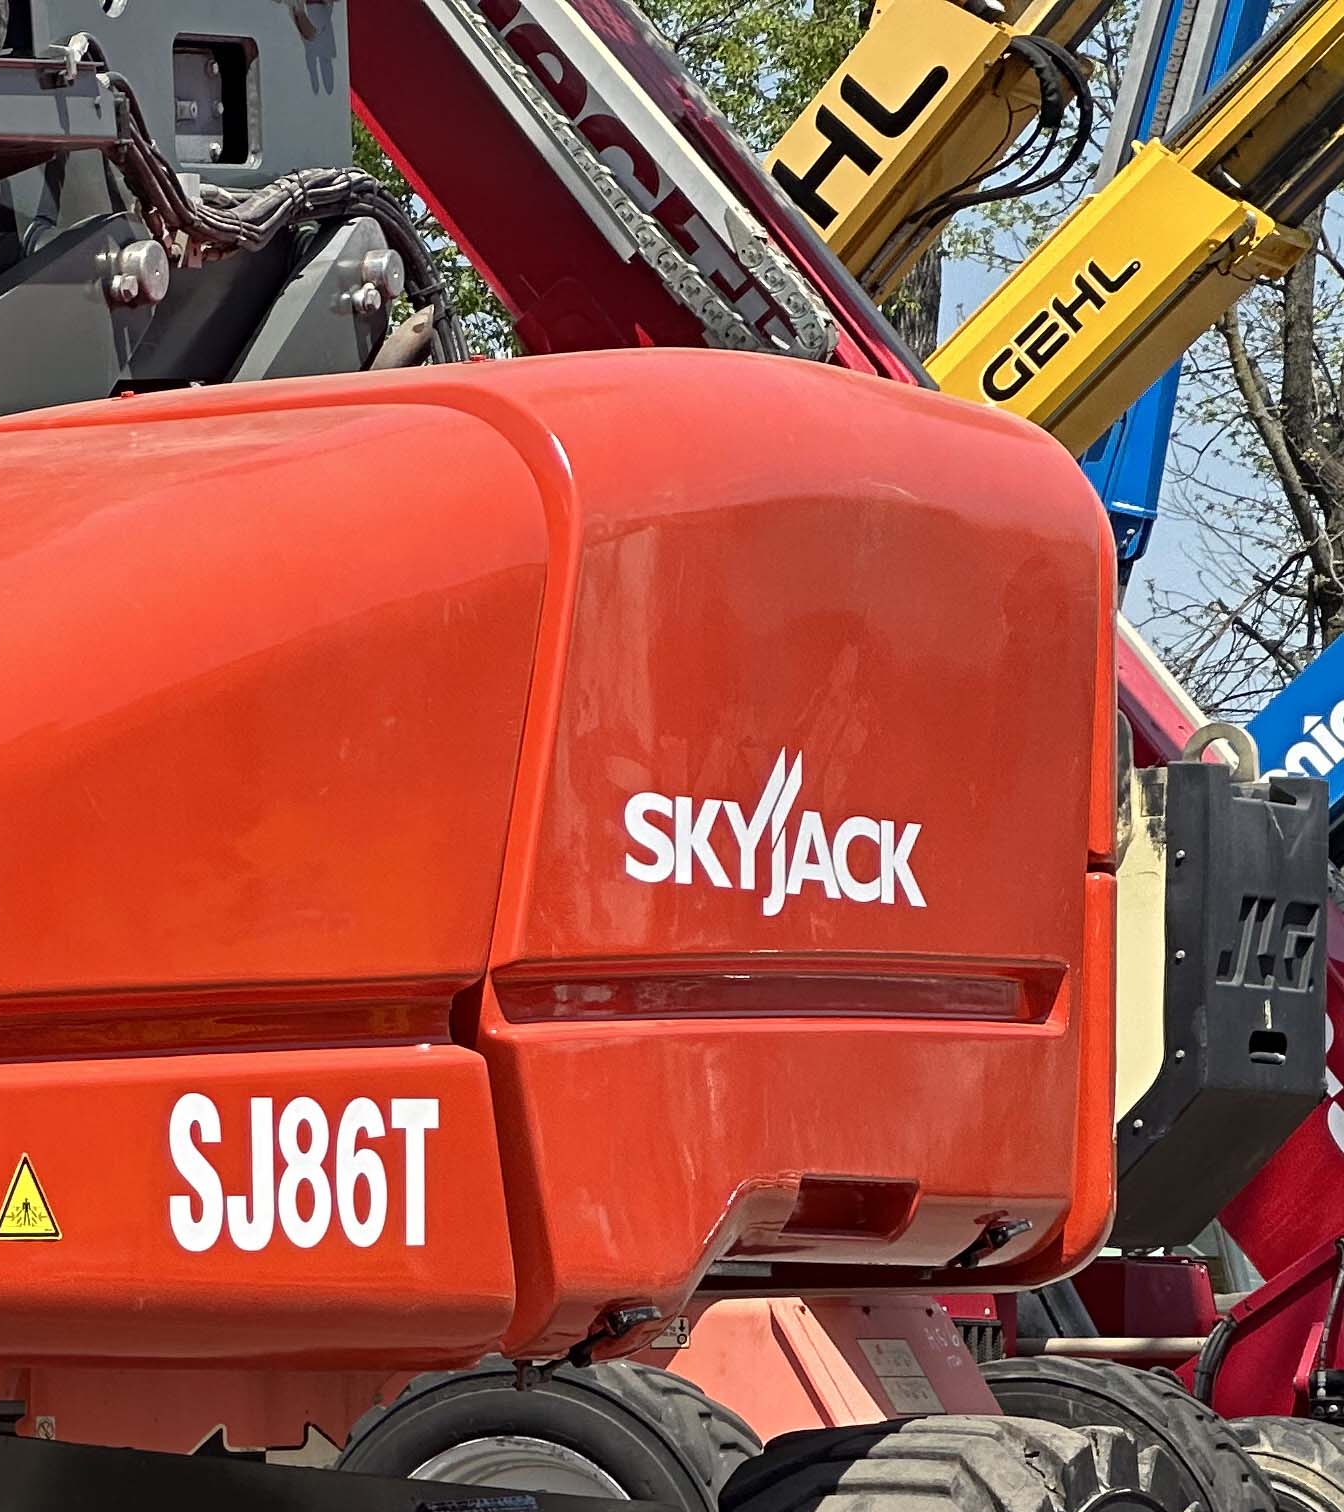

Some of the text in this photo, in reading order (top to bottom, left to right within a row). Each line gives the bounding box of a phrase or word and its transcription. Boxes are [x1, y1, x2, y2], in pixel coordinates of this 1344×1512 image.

[982, 260, 1142, 403] GEHL
[624, 746, 928, 917] SKYJACK
[1215, 895, 1320, 993] JLG
[169, 1092, 440, 1252] SJ86T
